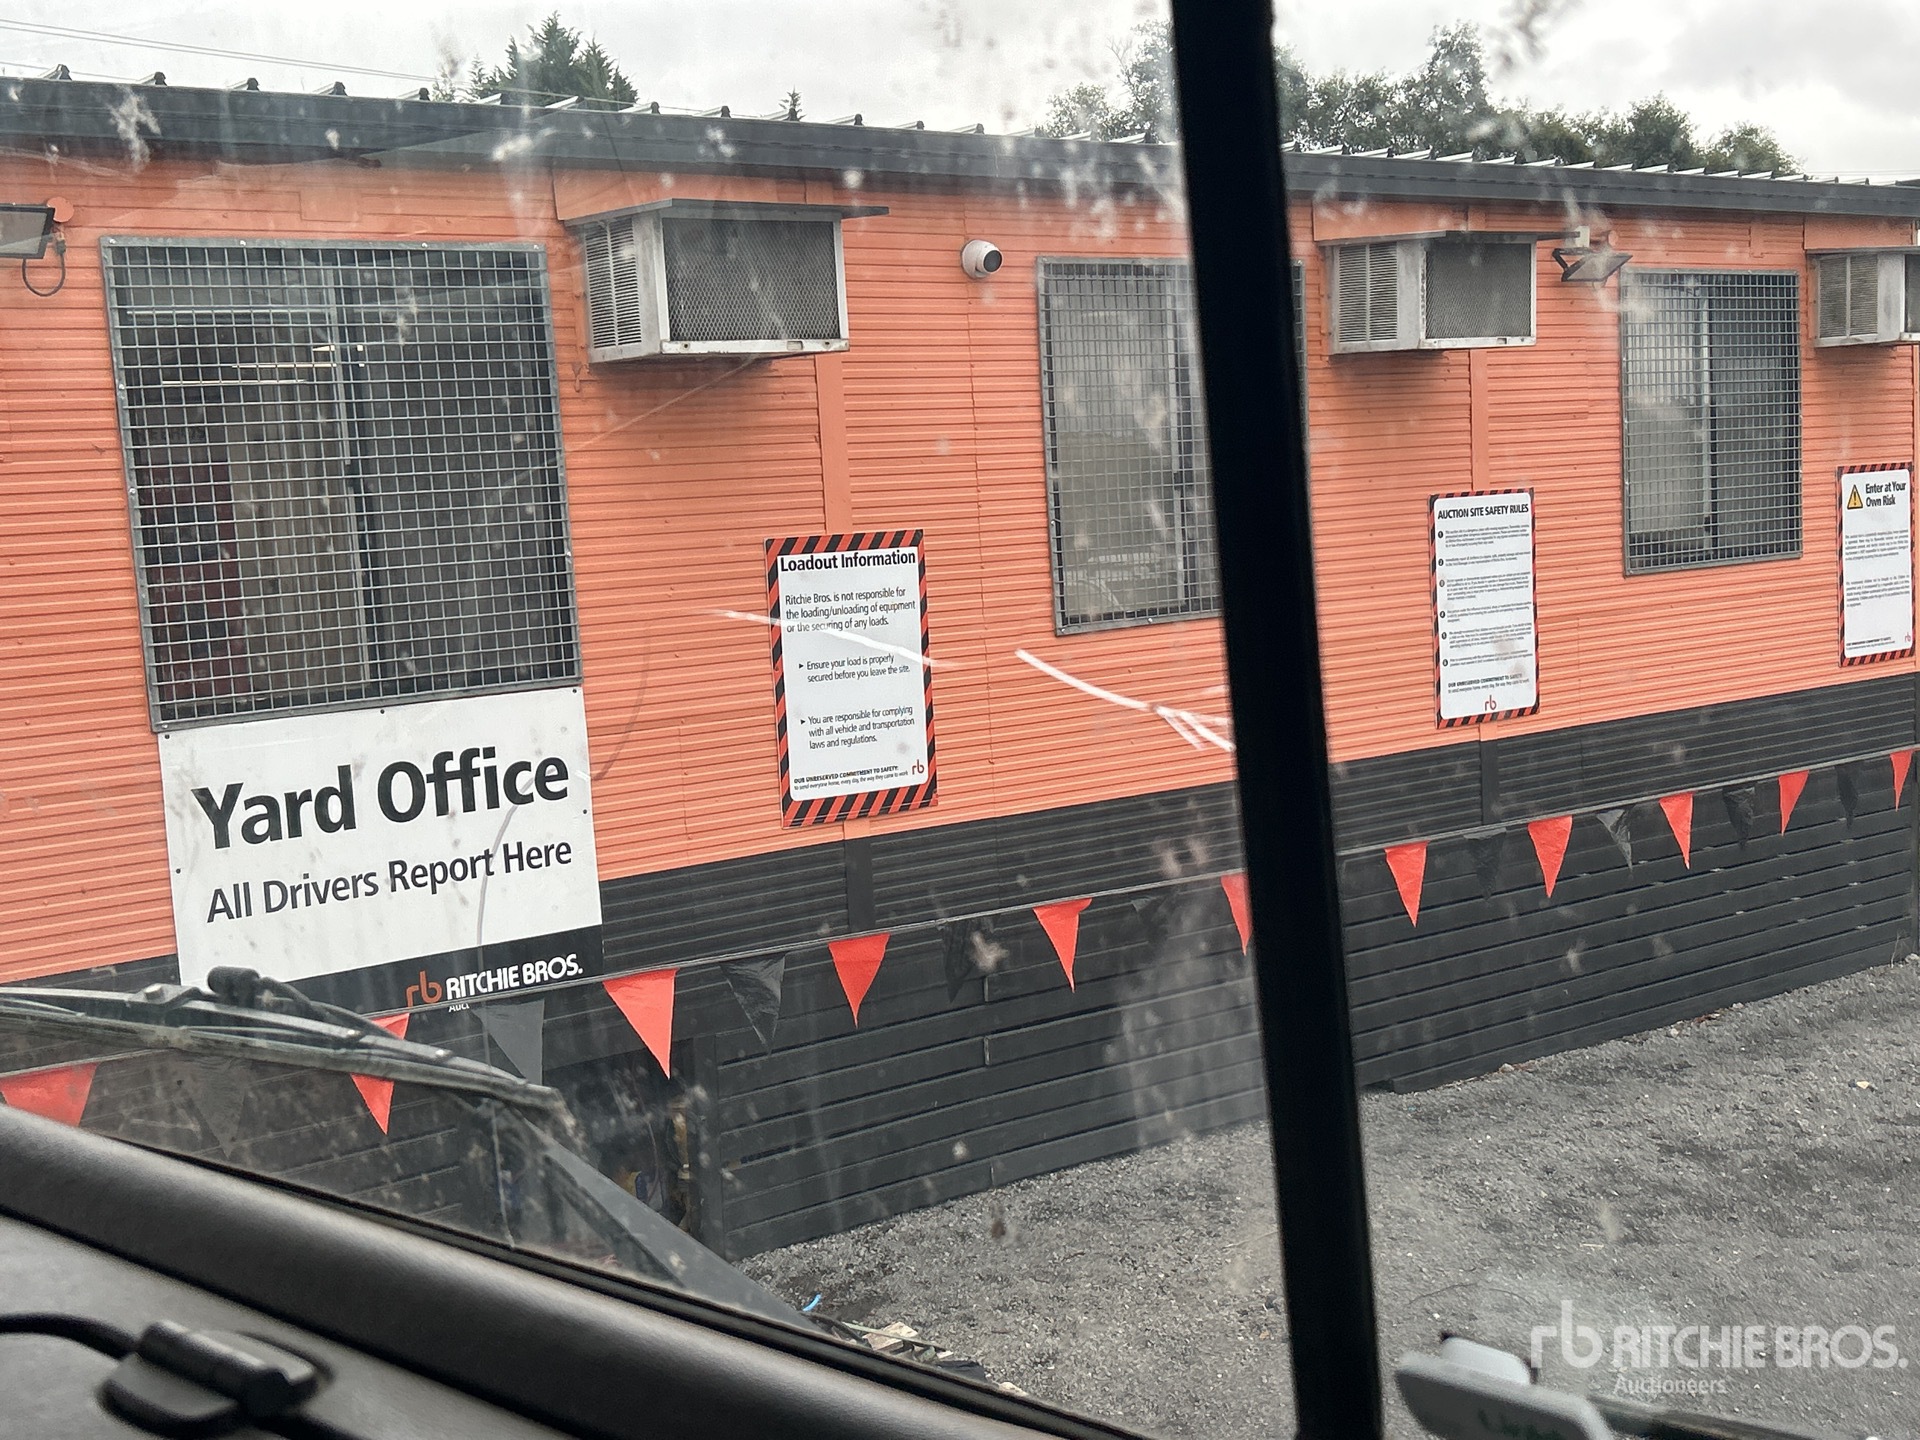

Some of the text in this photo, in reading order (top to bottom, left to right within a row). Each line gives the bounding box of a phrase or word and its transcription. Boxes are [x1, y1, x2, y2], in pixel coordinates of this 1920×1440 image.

[1866, 481, 1906, 494] Enter at Your
[1866, 494, 1895, 507] Own Risk
[1437, 504, 1529, 519] AUCTION SITE SAFETY RULES
[780, 550, 915, 571] Loadout Information
[785, 586, 906, 605] Ritchie Bros. is not responsible for
[786, 600, 915, 619] the loading/unloading of equipment
[786, 616, 889, 633] or the securing of any loads.
[806, 653, 894, 670] Ensure your load is properly
[807, 664, 910, 682] secured before you leave the site.
[1485, 695, 1497, 711] rb
[807, 706, 913, 725] You are responsible for complying
[809, 718, 915, 737] with all vehicle and transportation
[809, 734, 877, 749] laws and regulations.
[806, 773, 838, 782] UNRESERVED
[840, 769, 872, 778] COMMITMENT
[912, 759, 925, 775] rb
[191, 746, 569, 850] Yard Office
[206, 841, 573, 924] All Drivers Report Here
[405, 953, 583, 1008] rb RITCHIE BROS.
